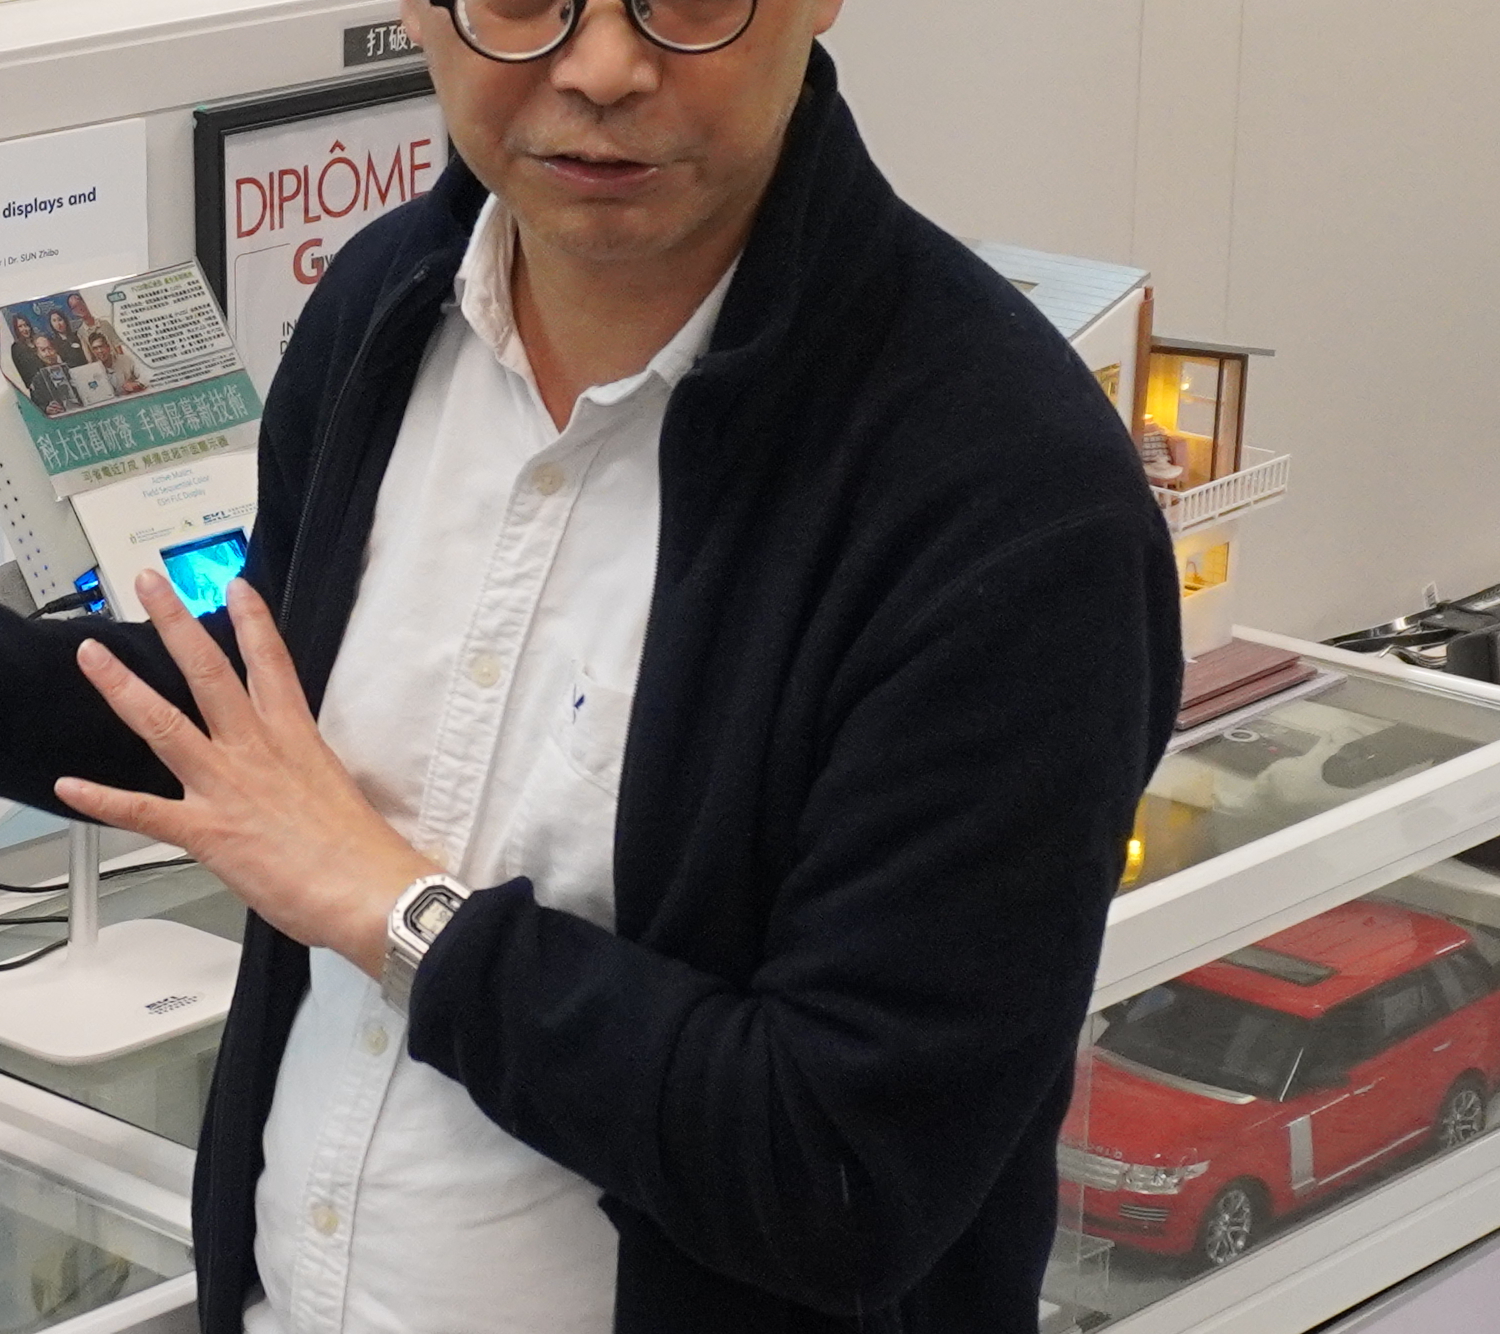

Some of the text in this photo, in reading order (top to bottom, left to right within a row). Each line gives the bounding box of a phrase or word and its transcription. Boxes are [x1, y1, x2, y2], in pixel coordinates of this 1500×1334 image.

[3, 198, 63, 220] displays
[68, 188, 96, 207] and
[236, 139, 431, 238] DIPLÔME
[9, 255, 19, 264] Dr.
[21, 250, 37, 261] SUN
[40, 247, 59, 258] Zhibo
[37, 417, 137, 469] 科大百萬研發
[193, 475, 209, 486] Color
